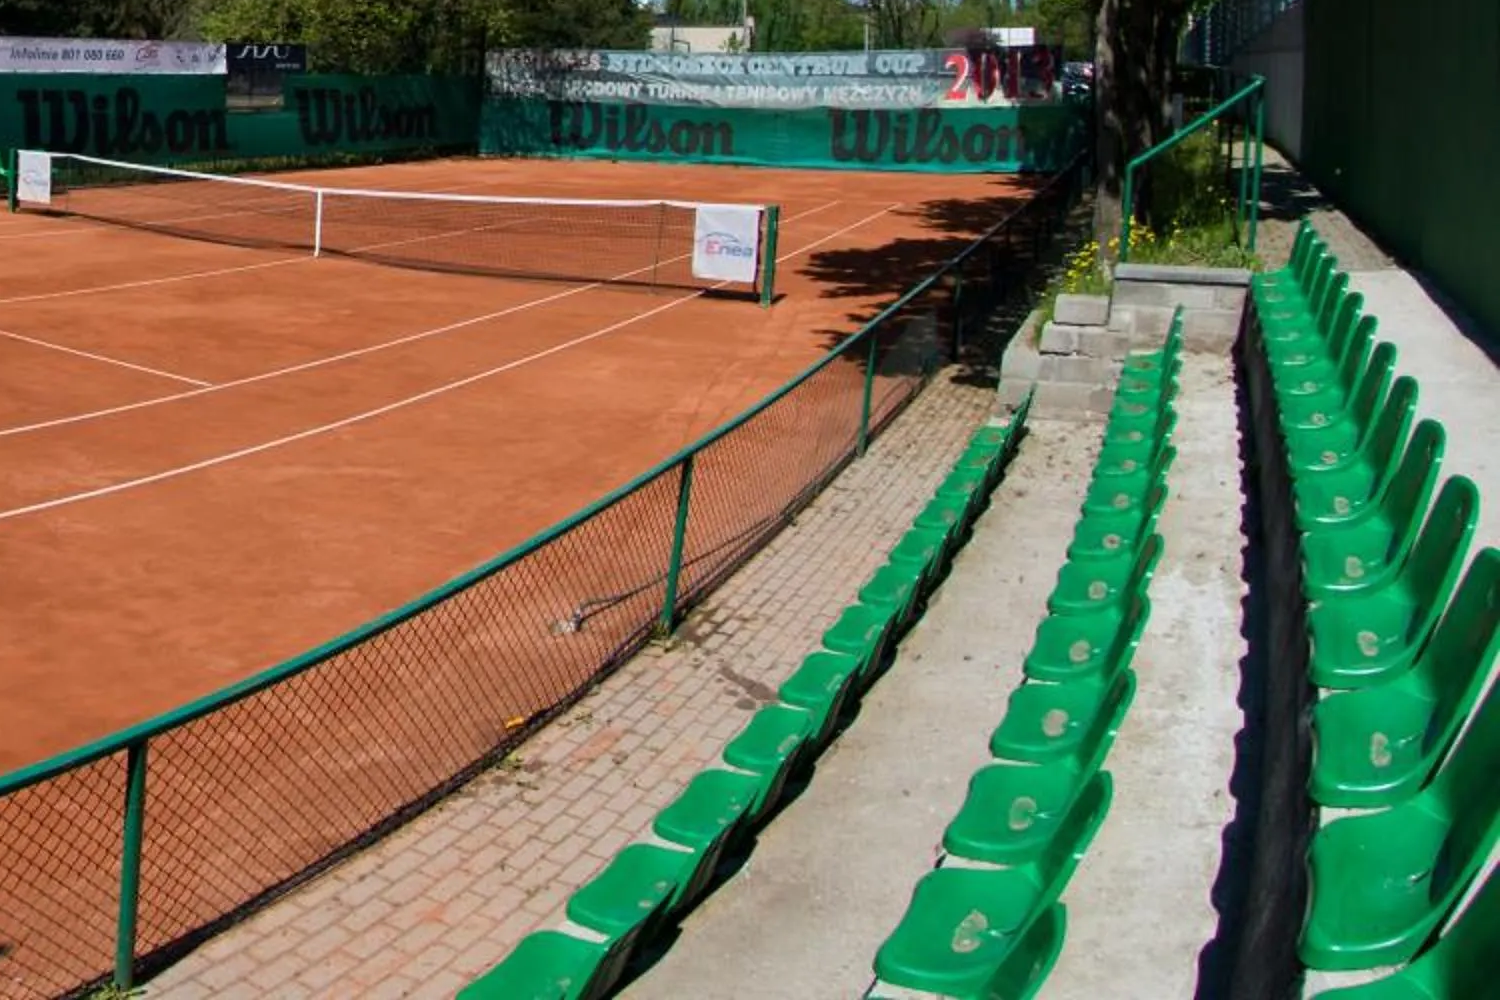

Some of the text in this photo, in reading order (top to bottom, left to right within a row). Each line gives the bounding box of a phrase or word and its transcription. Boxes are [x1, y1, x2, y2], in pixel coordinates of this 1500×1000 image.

[747, 54, 868, 75] CENTRUM
[875, 53, 926, 75] CUP
[17, 87, 232, 155] Wilson
[296, 86, 441, 147] Wilson
[548, 100, 735, 156] Wilson
[827, 105, 1029, 164] Wilson
